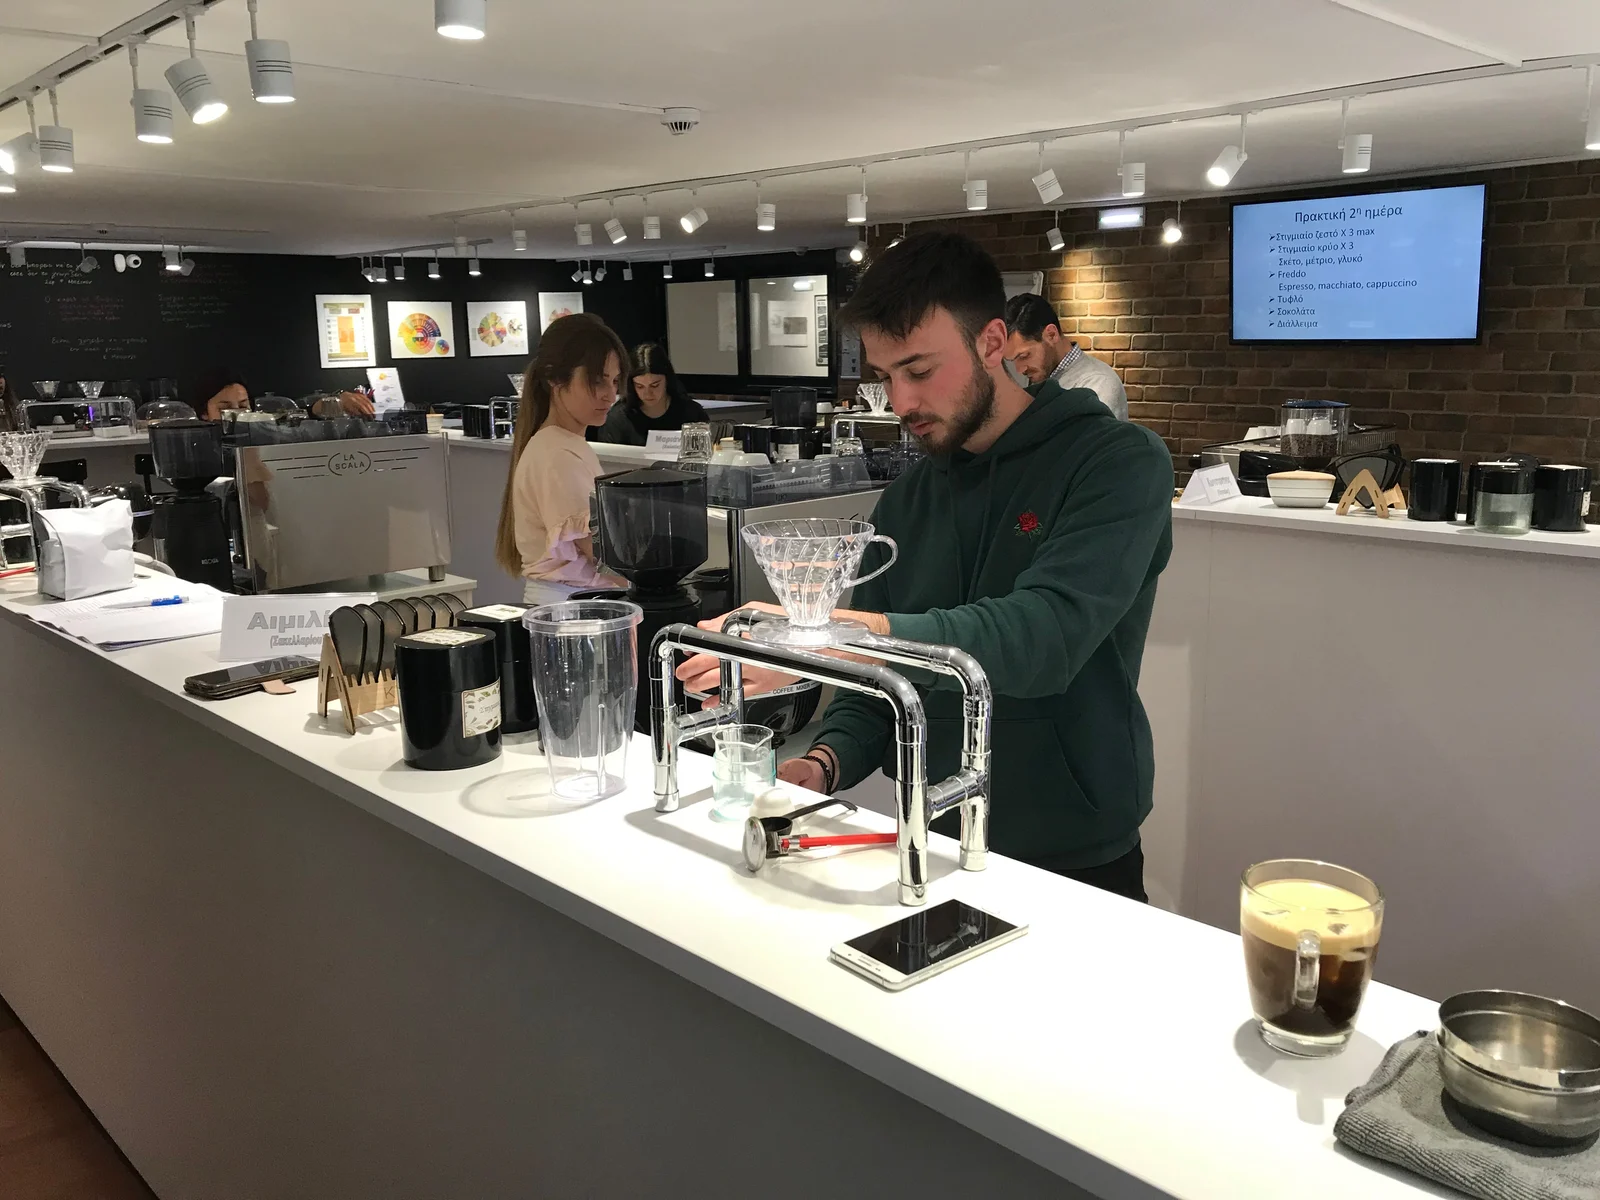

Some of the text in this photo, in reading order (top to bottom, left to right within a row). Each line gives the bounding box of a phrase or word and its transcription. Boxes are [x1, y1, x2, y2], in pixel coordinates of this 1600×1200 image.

[1295, 208, 1346, 224] Πρακτική
[1365, 205, 1403, 219] ημέρα
[1276, 231, 1313, 242] Στιγμιαίο
[1315, 229, 1338, 240] ζεστό
[1348, 228, 1354, 237] 3
[1357, 228, 1375, 237] max
[1278, 243, 1315, 255] Στιγμιαίο
[1317, 243, 1338, 254] κρύο
[1349, 242, 1354, 250] 3
[1279, 254, 1363, 267] Σκέτο, μέτριο, γλυκό
[1278, 270, 1306, 278] Freddo
[1279, 279, 1417, 292] Espresso, macchiato, cappuccino
[1278, 295, 1304, 304] Τυφλό
[1277, 307, 1315, 316] Σοκολάτα
[1277, 319, 1318, 328] Διάλλειμα
[335, 461, 365, 470] SCALA
[772, 687, 794, 695] COFFEE
